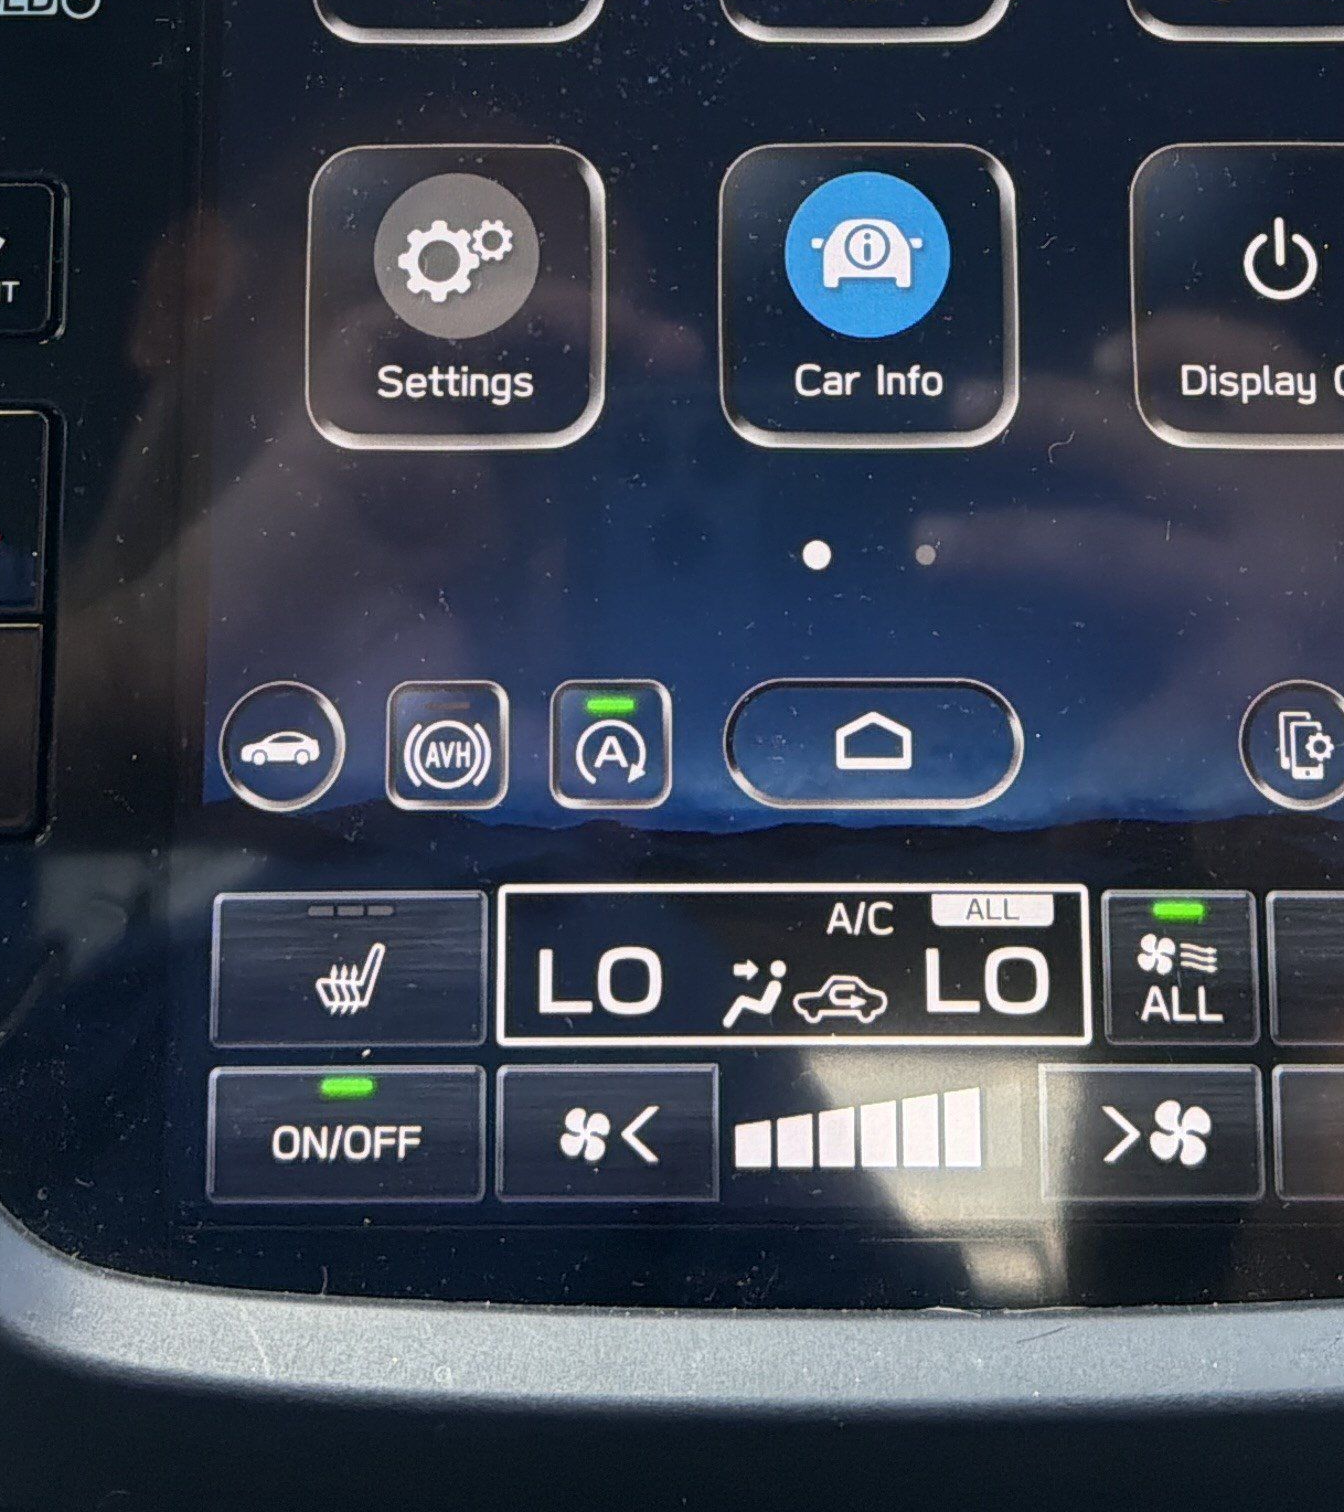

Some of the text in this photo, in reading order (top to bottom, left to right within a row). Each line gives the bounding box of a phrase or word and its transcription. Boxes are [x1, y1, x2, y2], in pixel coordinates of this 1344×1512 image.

[377, 364, 534, 406] Settings
[795, 363, 944, 397] Car Info
[1181, 364, 1317, 406] Display
[425, 740, 472, 769] AVH
[826, 897, 1020, 936] A/C ALL
[538, 946, 663, 1015] LO
[925, 946, 1050, 1015] LO
[1140, 985, 1224, 1022] ALL
[272, 1124, 422, 1161] ON/OFF
